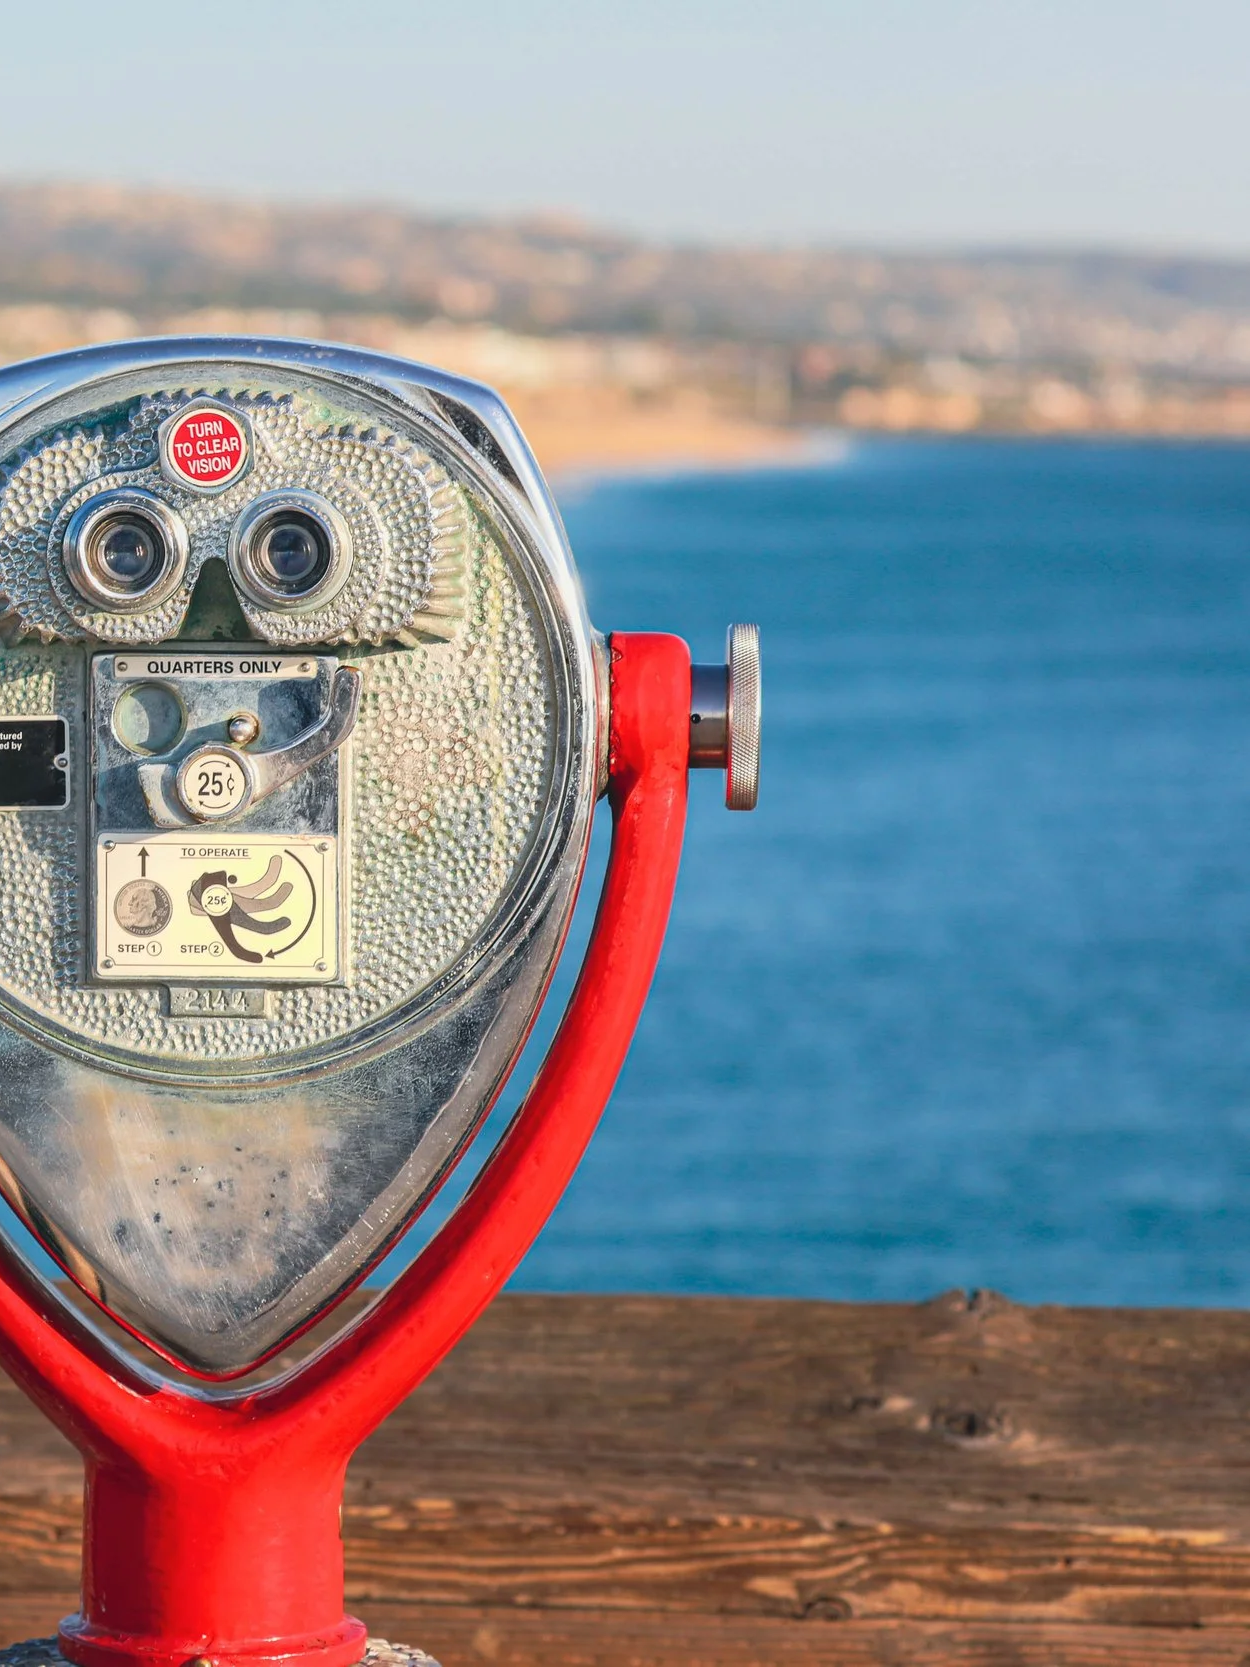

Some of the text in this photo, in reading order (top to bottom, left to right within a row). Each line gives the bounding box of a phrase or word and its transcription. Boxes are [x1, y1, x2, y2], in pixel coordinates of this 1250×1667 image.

[187, 421, 223, 438] TURN
[175, 437, 239, 457] TO CLEAR
[187, 456, 231, 474] VISION
[147, 660, 282, 674] QUARTERS ONLY
[11, 741, 22, 752] by
[198, 771, 235, 797] 25¢
[181, 847, 249, 857] TO OPERATE
[207, 895, 227, 906] 25¢
[117, 943, 145, 953] STEP
[180, 944, 207, 953] STEP
[185, 988, 248, 1012] 2144
